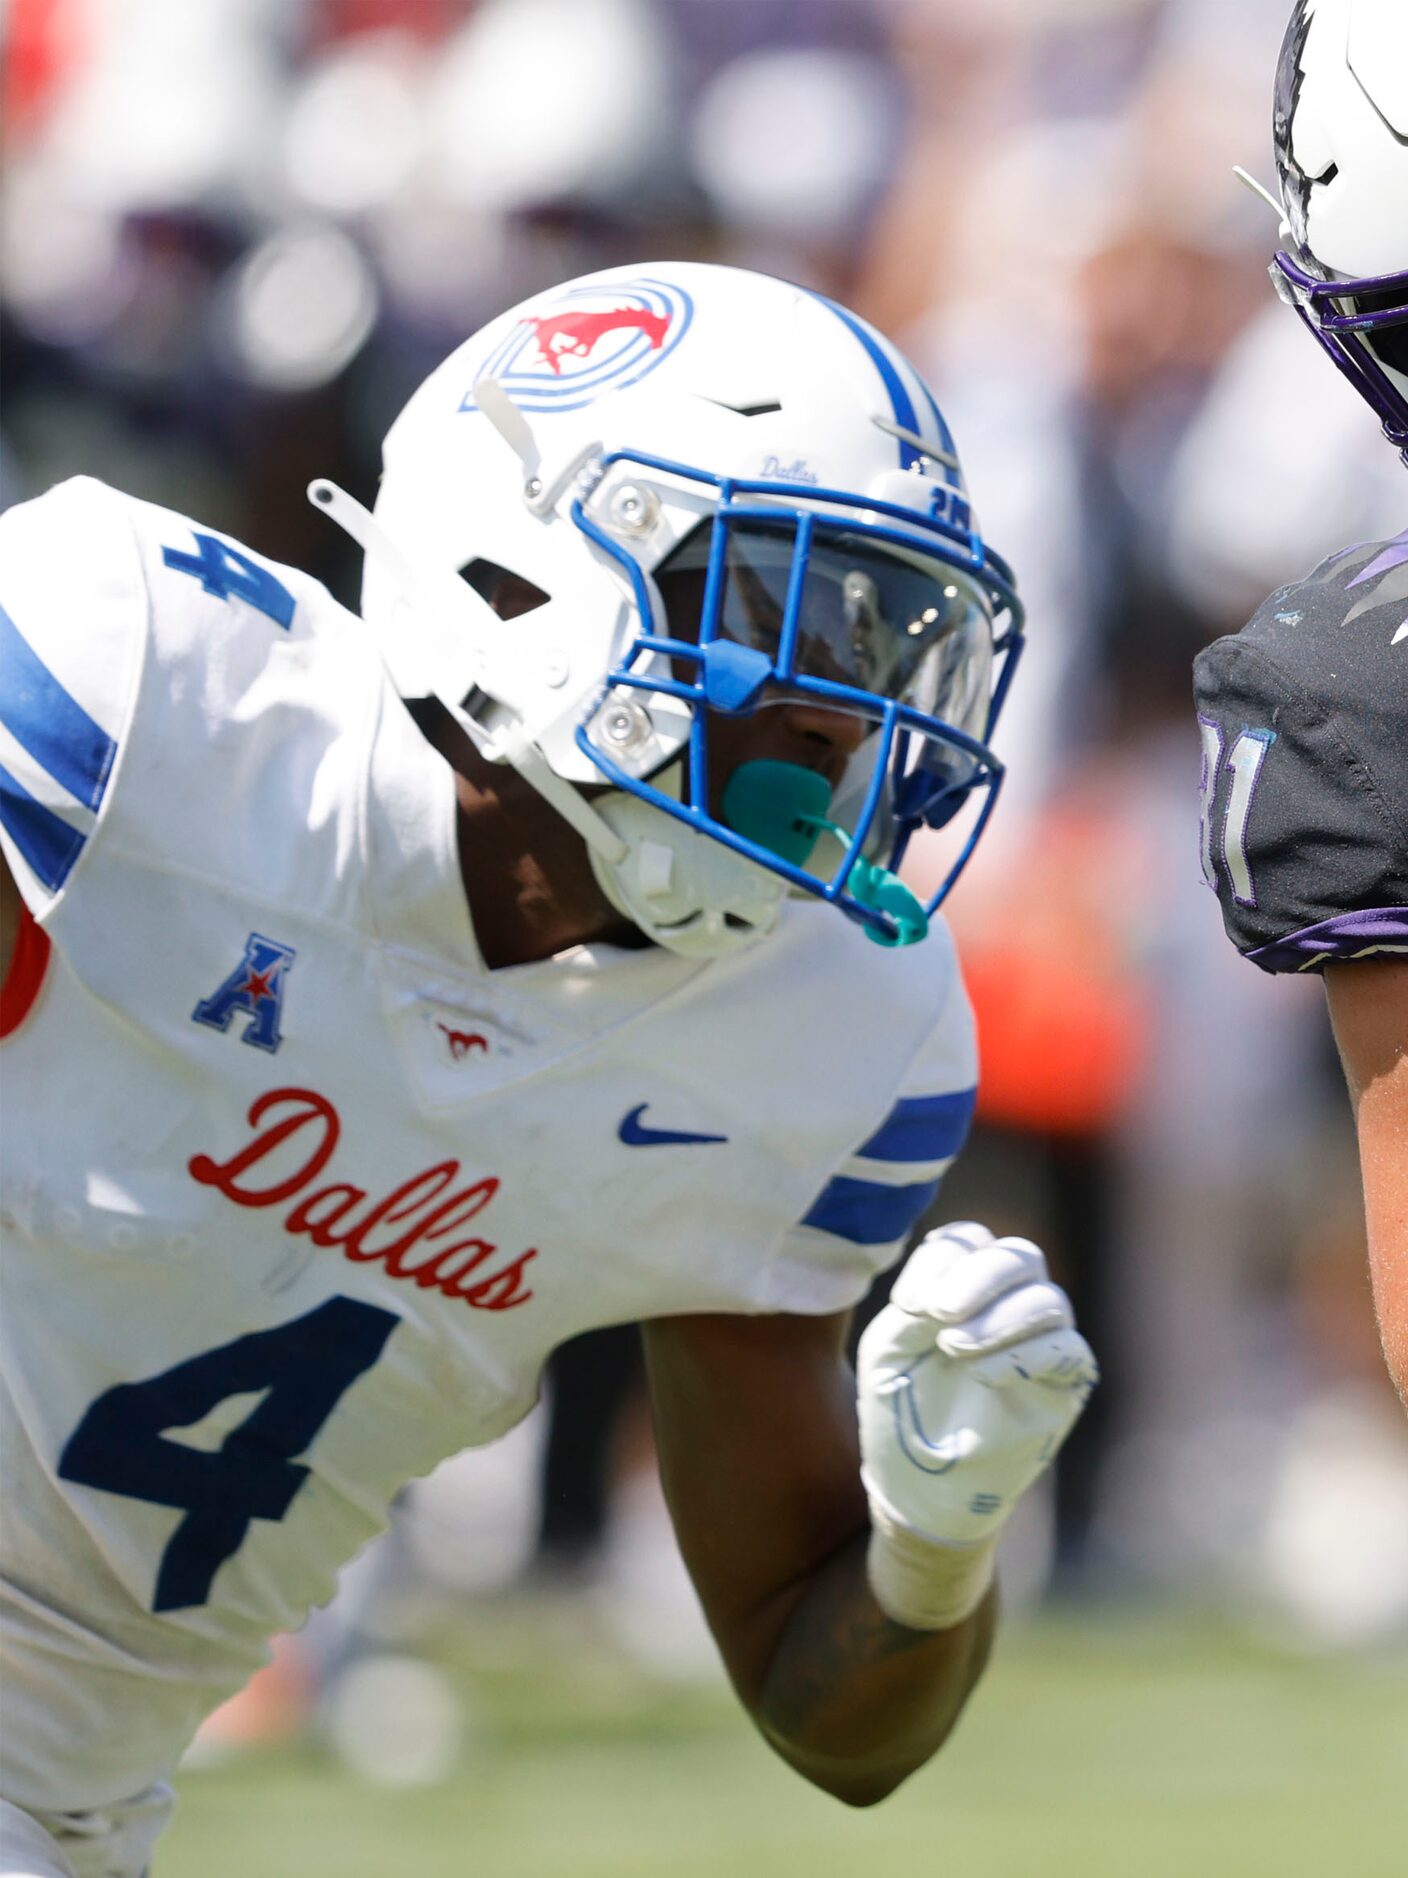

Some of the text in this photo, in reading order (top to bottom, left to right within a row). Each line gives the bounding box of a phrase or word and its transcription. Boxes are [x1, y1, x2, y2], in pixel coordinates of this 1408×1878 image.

[160, 530, 297, 632] 4
[187, 1086, 538, 1311] Dallas
[58, 1294, 402, 1613] 4
